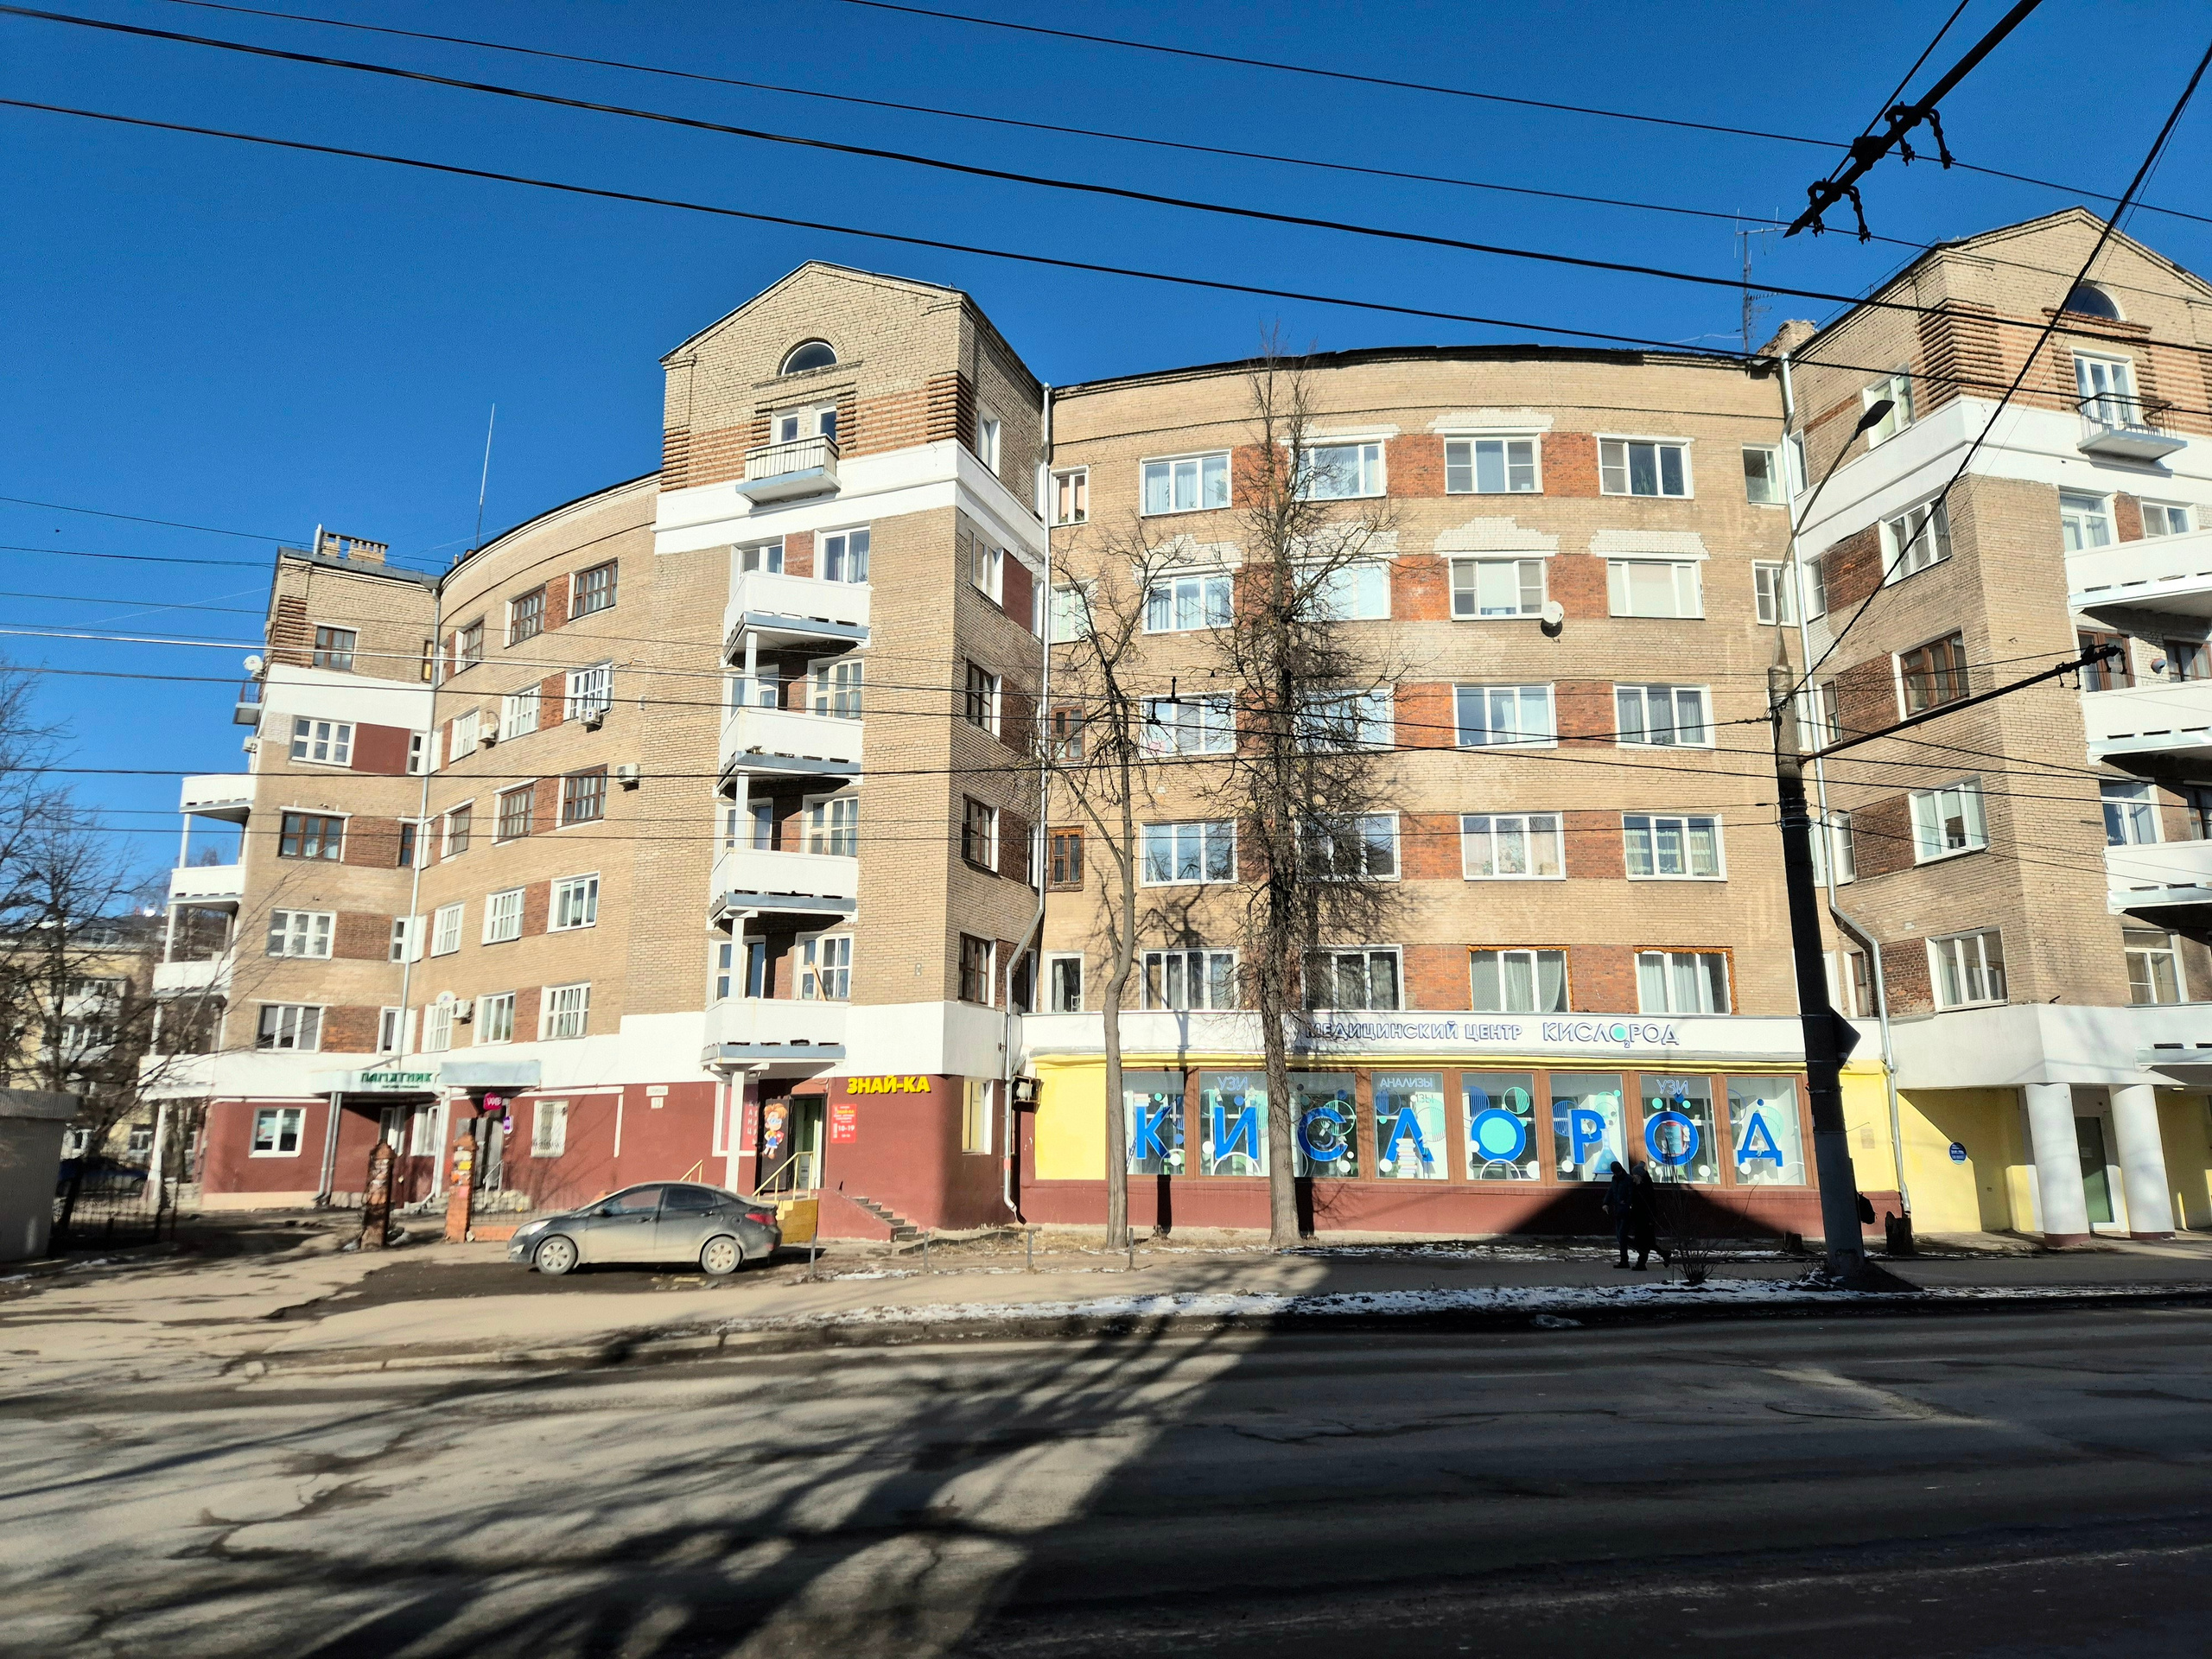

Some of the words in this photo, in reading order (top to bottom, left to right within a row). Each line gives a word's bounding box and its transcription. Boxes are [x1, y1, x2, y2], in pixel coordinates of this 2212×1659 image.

[1306, 1020, 1458, 1041] МЕДИЦИНСКИЙ
[1465, 1024, 1523, 1041] ЦЕНТР
[1542, 1022, 1679, 1046] КИСЛОРОД
[361, 1072, 432, 1083] ПАМЯТНИК
[846, 1075, 931, 1095] ЗНАЙ-КА
[1217, 1077, 1249, 1090] УЗИ
[1380, 1077, 1433, 1088] АНАЛИЗЫ
[1656, 1079, 1689, 1095] УЗИ
